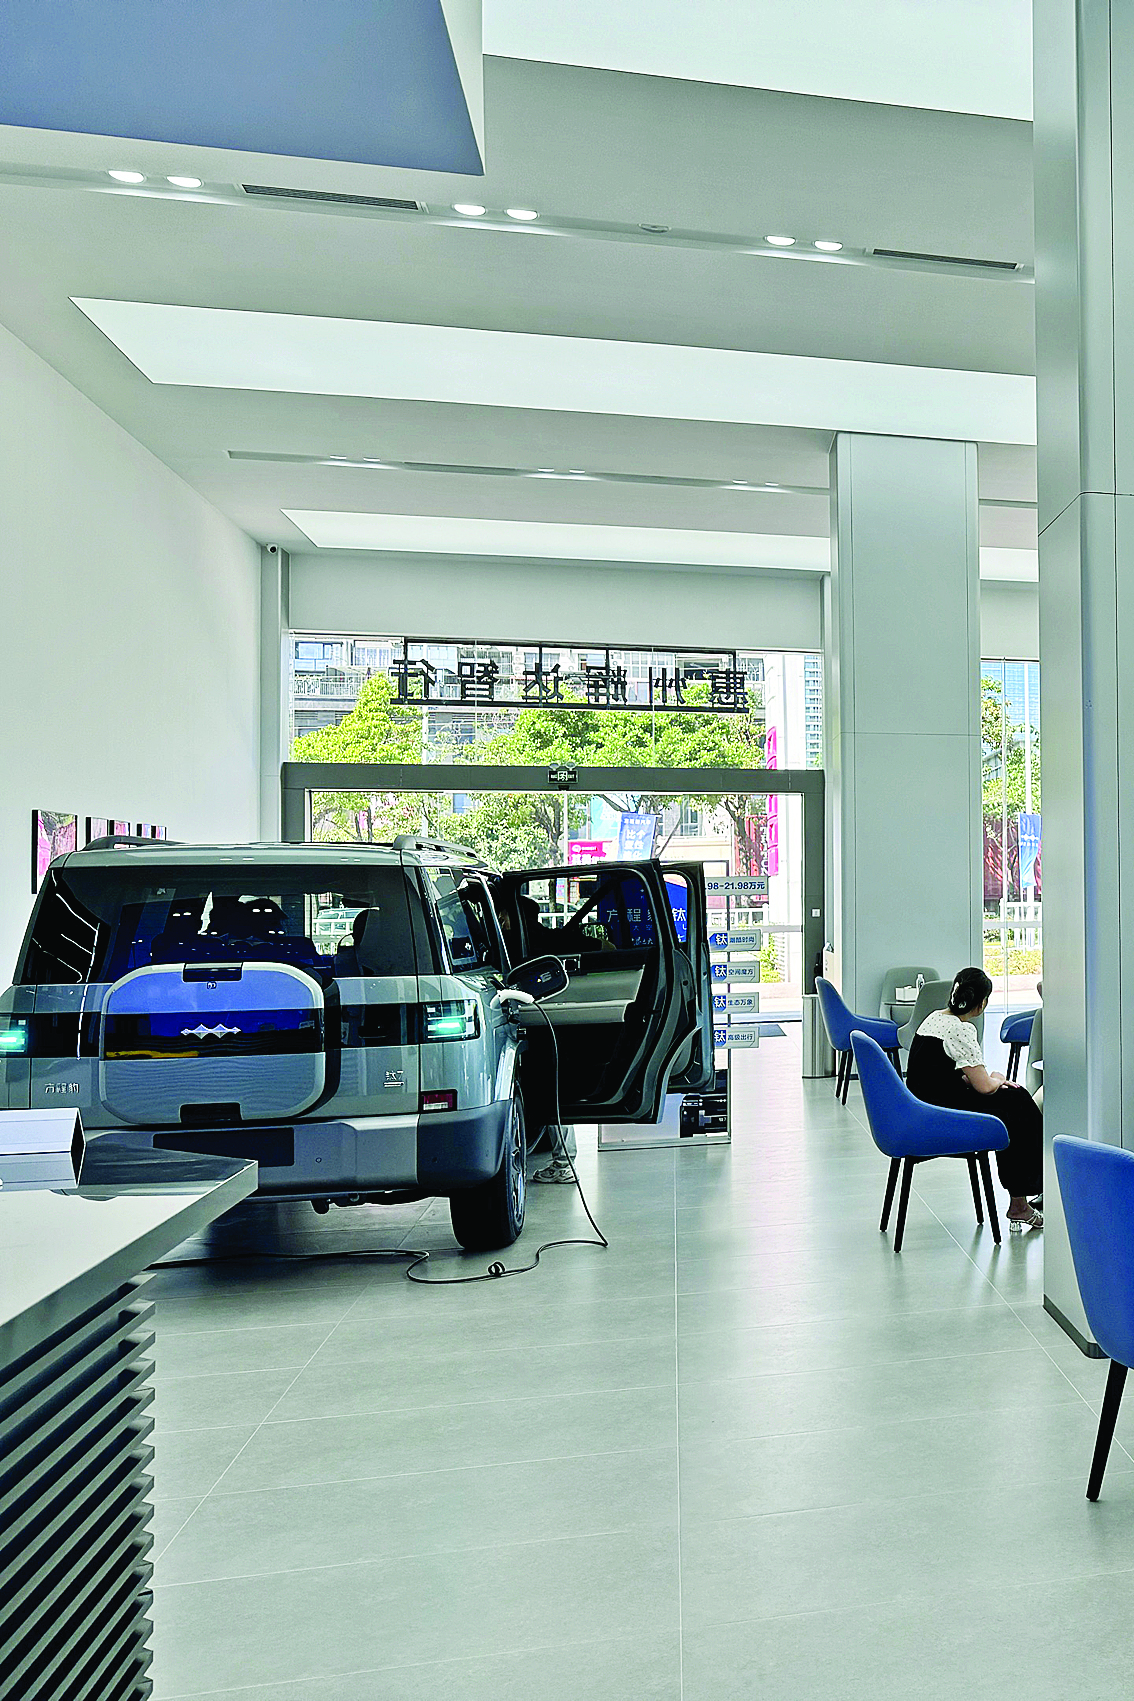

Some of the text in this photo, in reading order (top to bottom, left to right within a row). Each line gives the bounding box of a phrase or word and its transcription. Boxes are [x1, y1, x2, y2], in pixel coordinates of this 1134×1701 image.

[715, 933, 728, 946] 钛
[714, 965, 727, 978] 钛
[713, 996, 726, 1008] 钛
[713, 1030, 726, 1043] 钛
